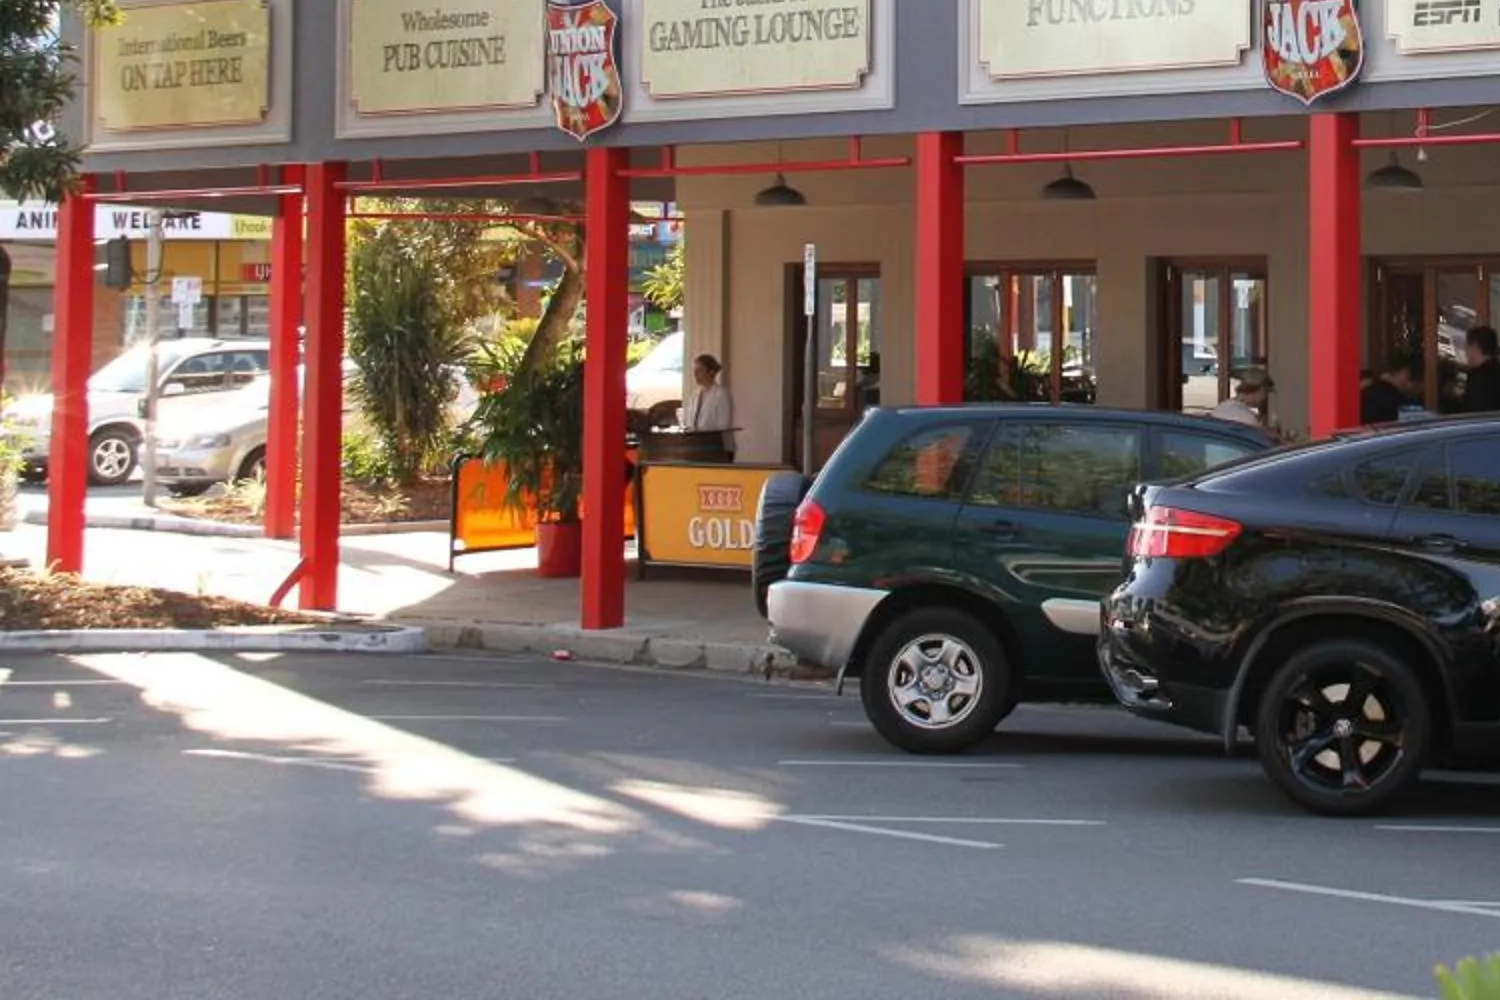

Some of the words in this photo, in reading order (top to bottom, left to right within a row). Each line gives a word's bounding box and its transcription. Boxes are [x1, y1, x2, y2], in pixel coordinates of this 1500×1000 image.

[401, 9, 490, 34] Wholesome
[649, 14, 750, 53] GAMING
[753, 6, 860, 47] LOUNGE
[1413, 0, 1481, 27] ESPN
[208, 29, 247, 50] Beers
[383, 41, 421, 73] PUB
[423, 34, 507, 71] CUISINE
[550, 24, 606, 55] UNION
[121, 63, 150, 91] ON
[151, 61, 185, 89] TAP
[189, 55, 242, 87] HERE
[551, 52, 609, 108] JACK
[113, 211, 202, 230] WELARE
[688, 516, 754, 550] GOLD
